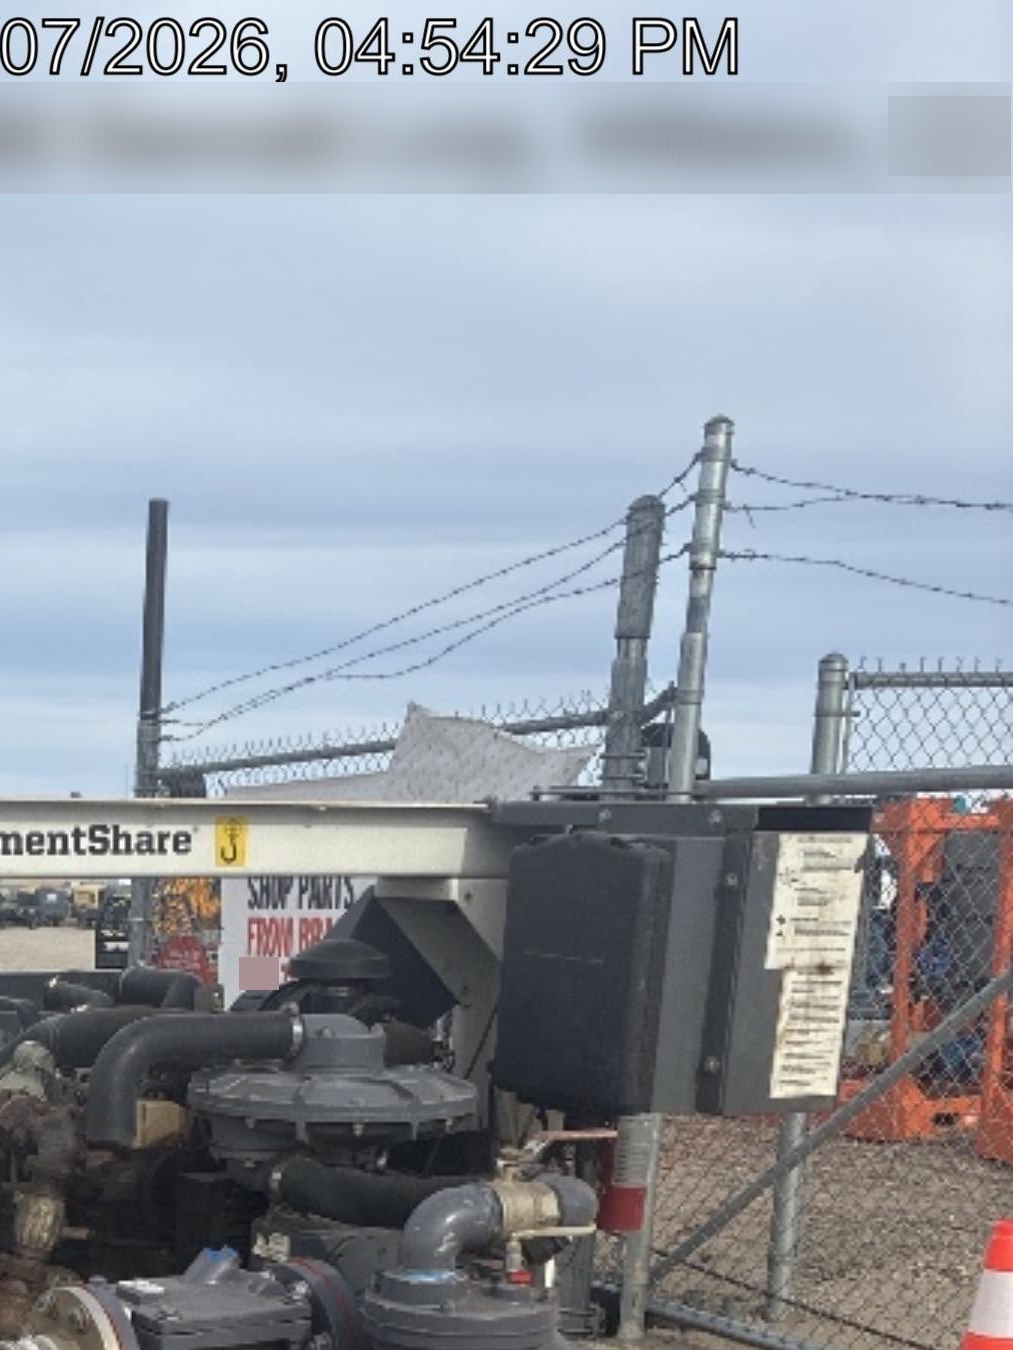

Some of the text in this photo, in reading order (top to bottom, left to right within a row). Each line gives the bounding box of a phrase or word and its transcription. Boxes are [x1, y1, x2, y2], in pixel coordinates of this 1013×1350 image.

[247, 876, 354, 910] SHOP PARTS
[247, 917, 293, 957] FROM
